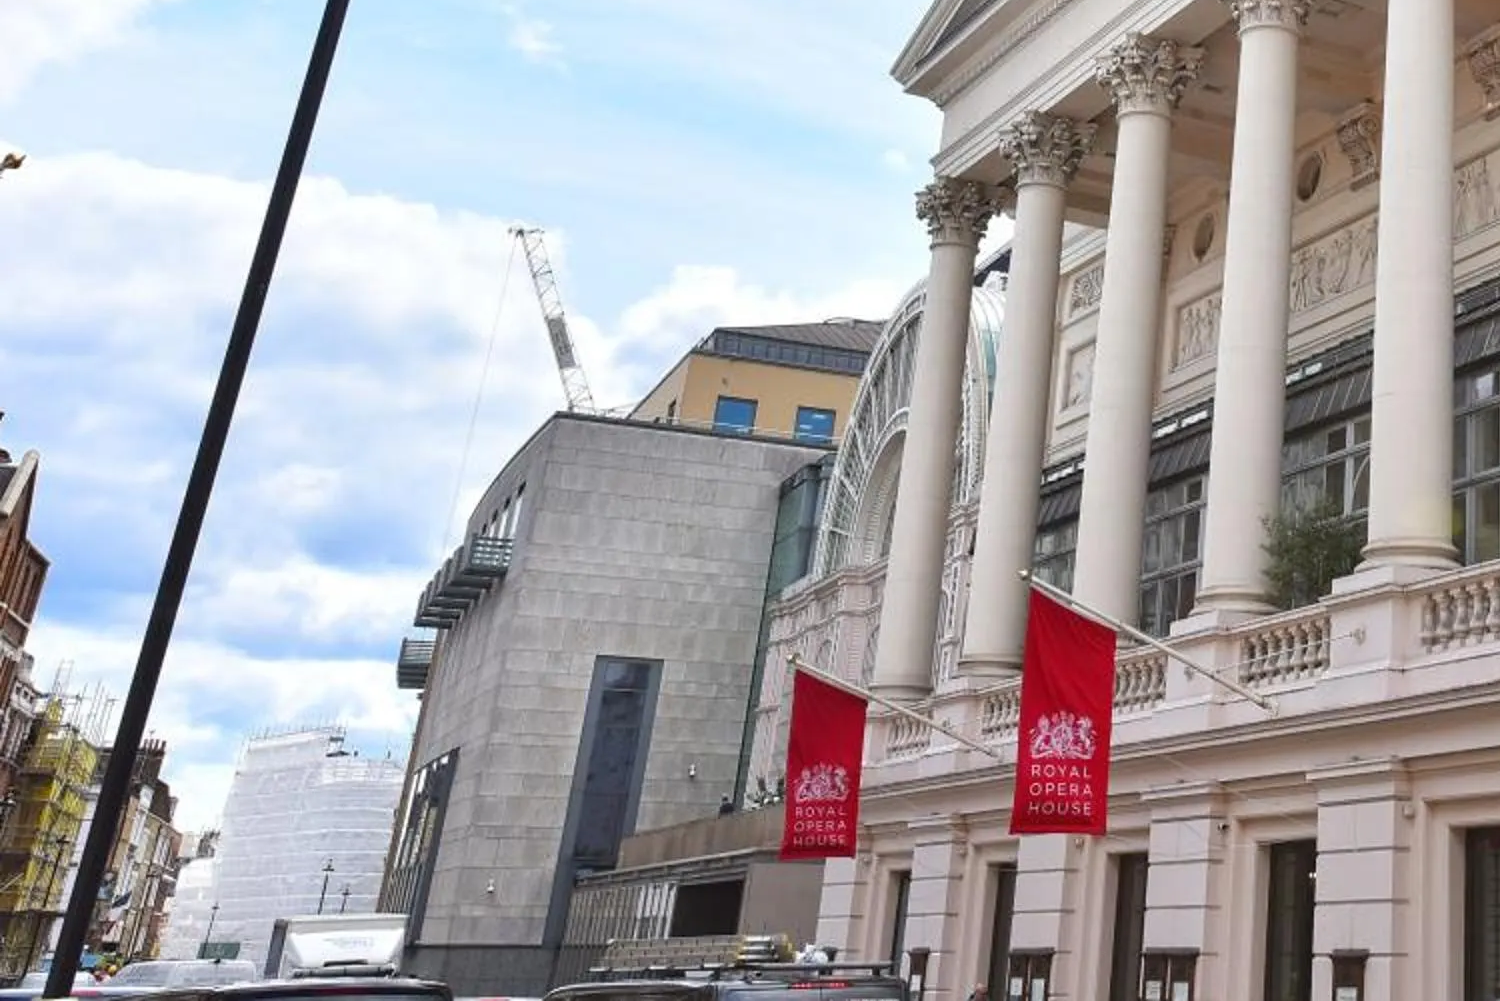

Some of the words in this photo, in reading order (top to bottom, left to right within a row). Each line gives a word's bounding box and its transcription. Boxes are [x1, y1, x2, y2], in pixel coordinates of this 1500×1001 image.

[1031, 764, 1092, 778] ROYAL
[1029, 782, 1093, 797] OPERA
[795, 806, 848, 819] ROYAL
[1027, 801, 1092, 816] HOUSE
[793, 820, 847, 832] OPERA
[792, 834, 847, 847] HOUSE
